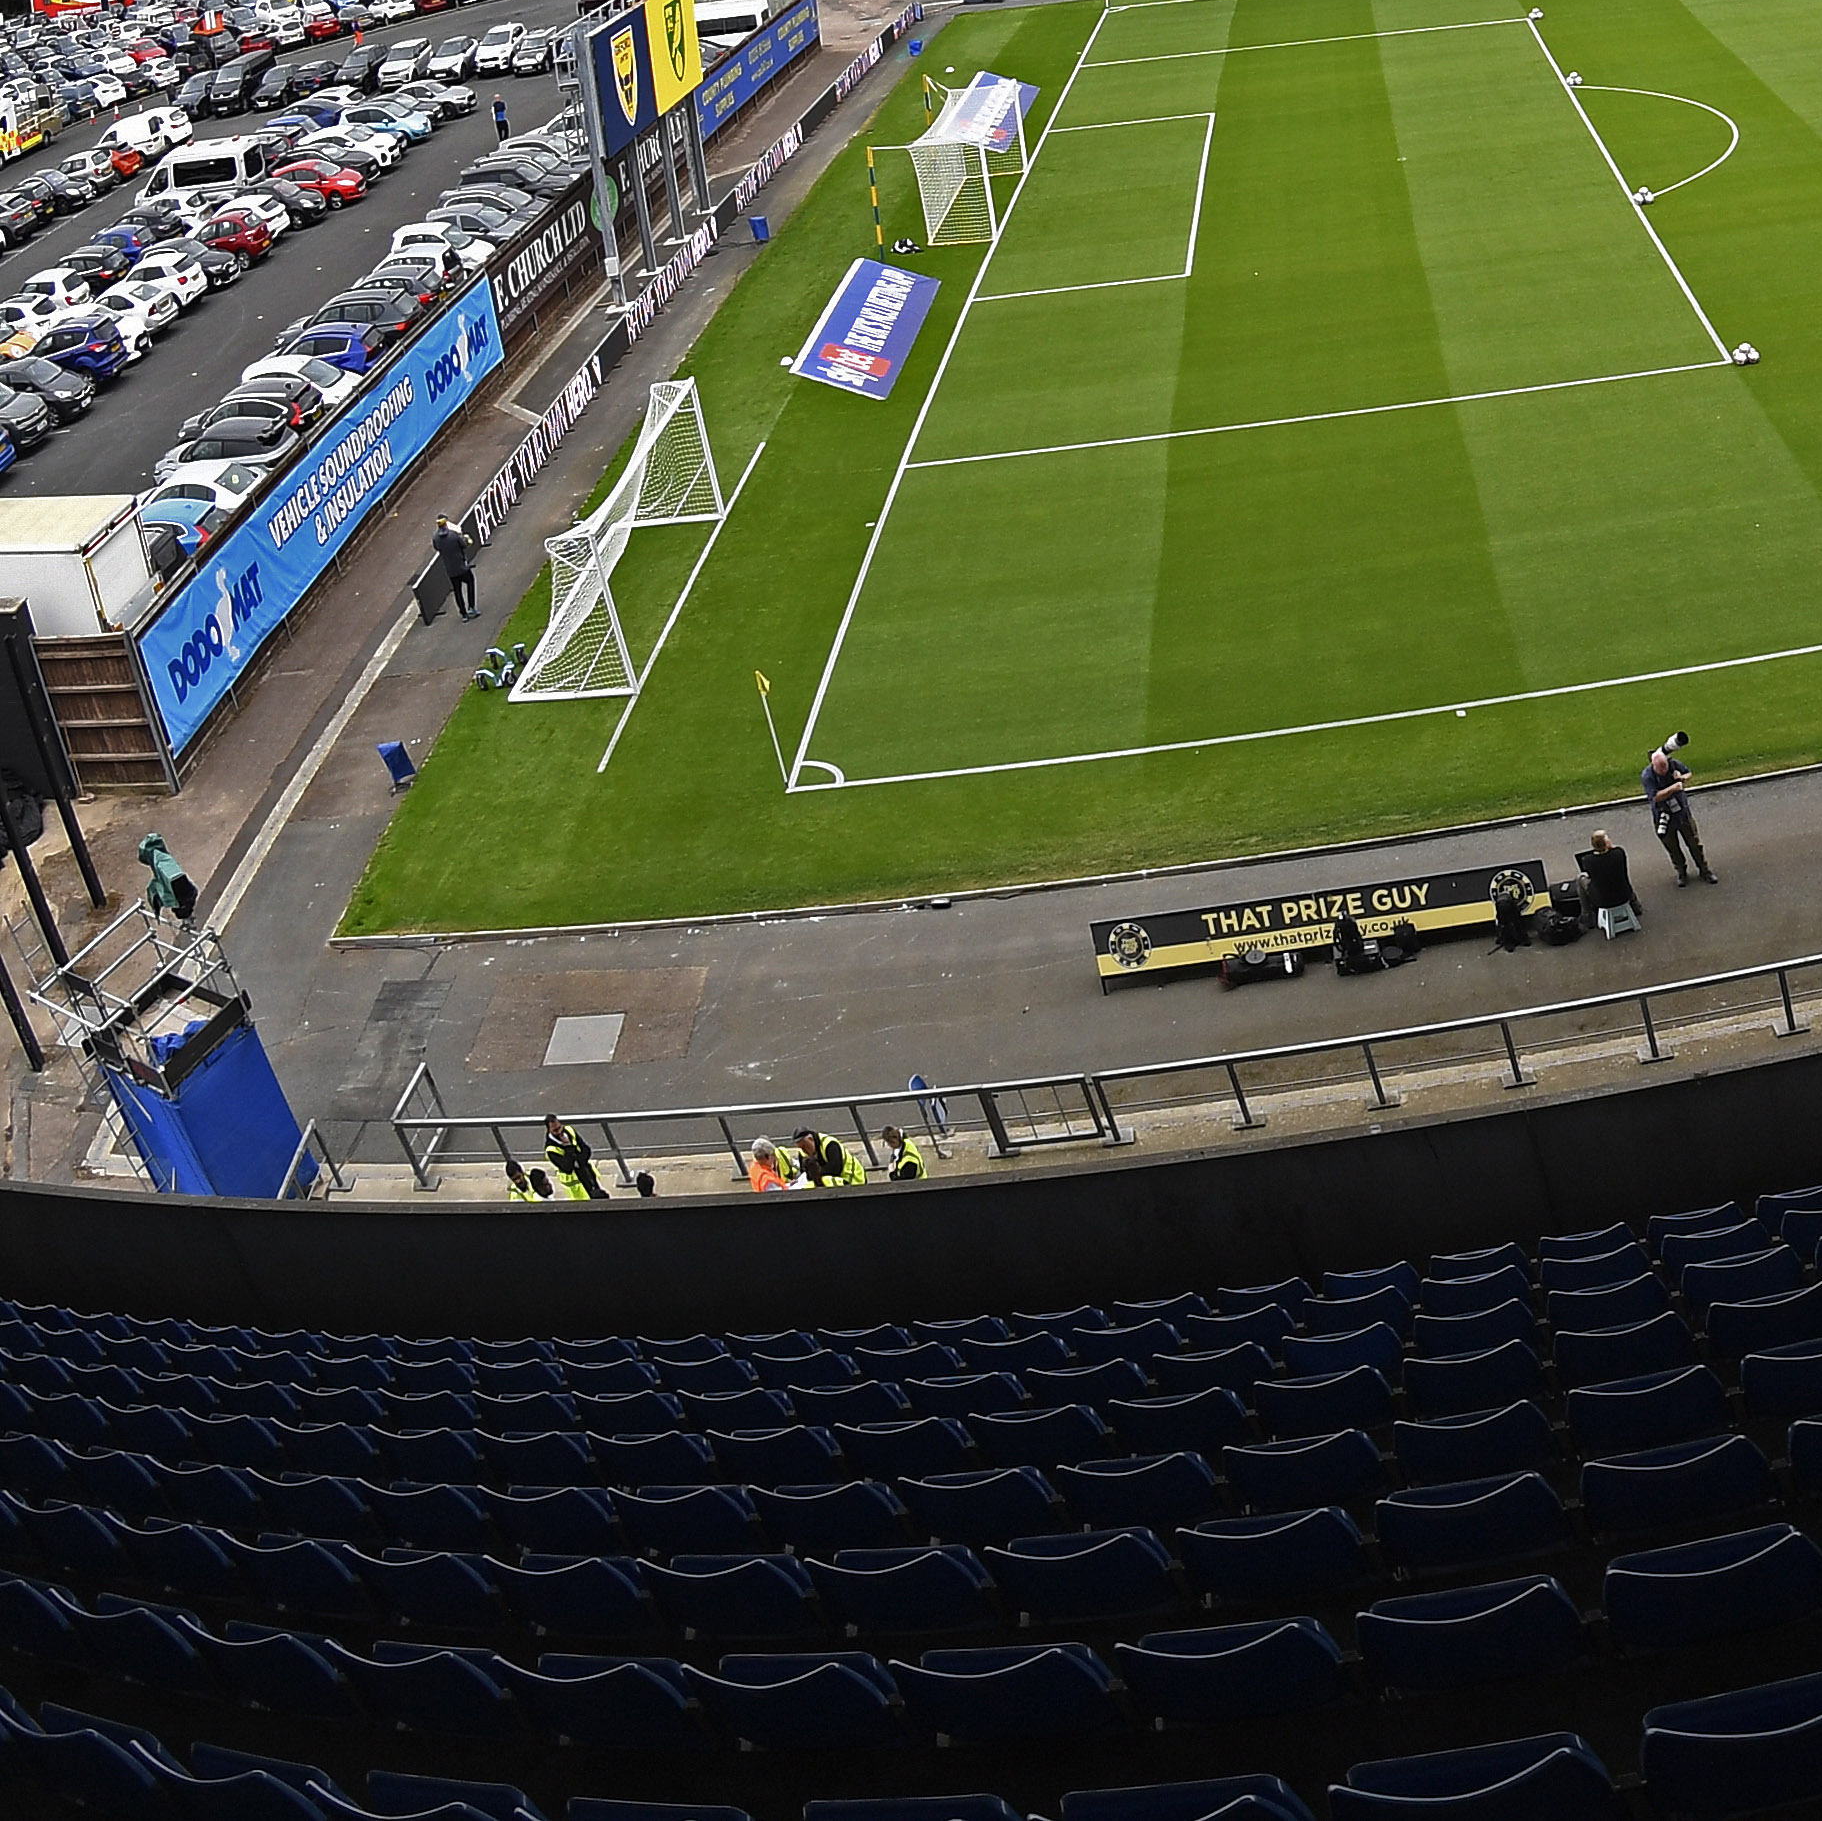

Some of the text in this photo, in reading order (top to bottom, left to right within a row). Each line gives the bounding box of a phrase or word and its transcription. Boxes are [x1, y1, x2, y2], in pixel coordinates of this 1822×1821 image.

[507, 220, 564, 299] CHURCH
[562, 199, 587, 247] LTD
[425, 313, 489, 404] DODO MAT
[268, 373, 415, 550] VEHICLE SOUNDPROOFING
[313, 438, 394, 546] & INSULATION
[474, 459, 518, 546] BECOME
[543, 400, 569, 456] OWN
[565, 366, 597, 426] HERO.
[167, 560, 264, 705] DODO MAT
[1201, 882, 1430, 936] THAT PRIZE GUY
